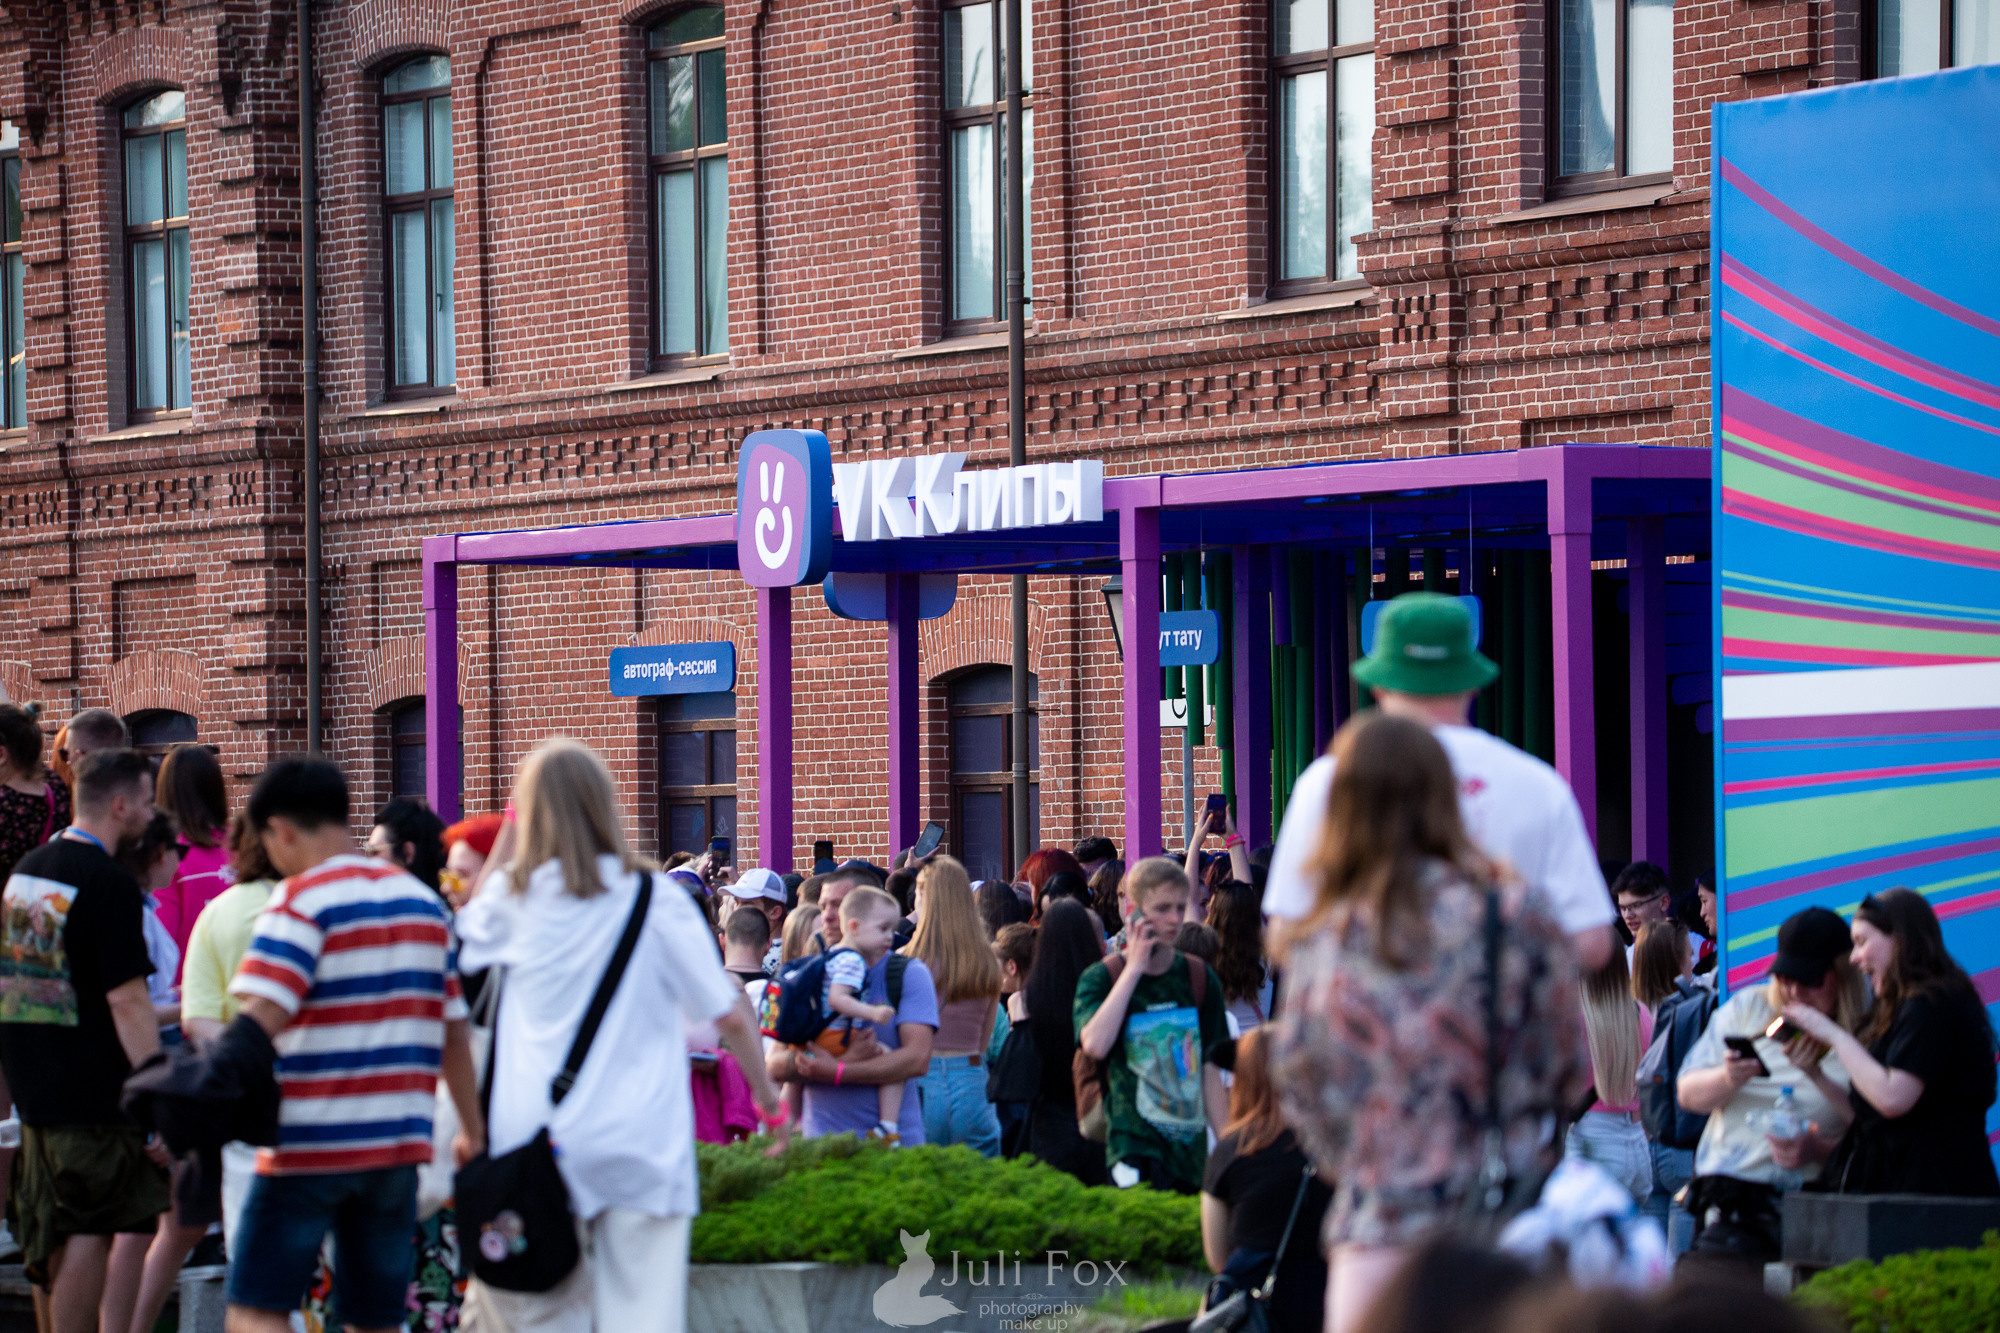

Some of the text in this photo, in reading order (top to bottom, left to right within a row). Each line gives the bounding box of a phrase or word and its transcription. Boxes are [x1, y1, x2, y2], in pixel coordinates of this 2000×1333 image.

[832, 453, 1103, 542] VK Клипы
[1159, 629, 1202, 651] ут тату
[623, 657, 717, 682] автограф-сессия
